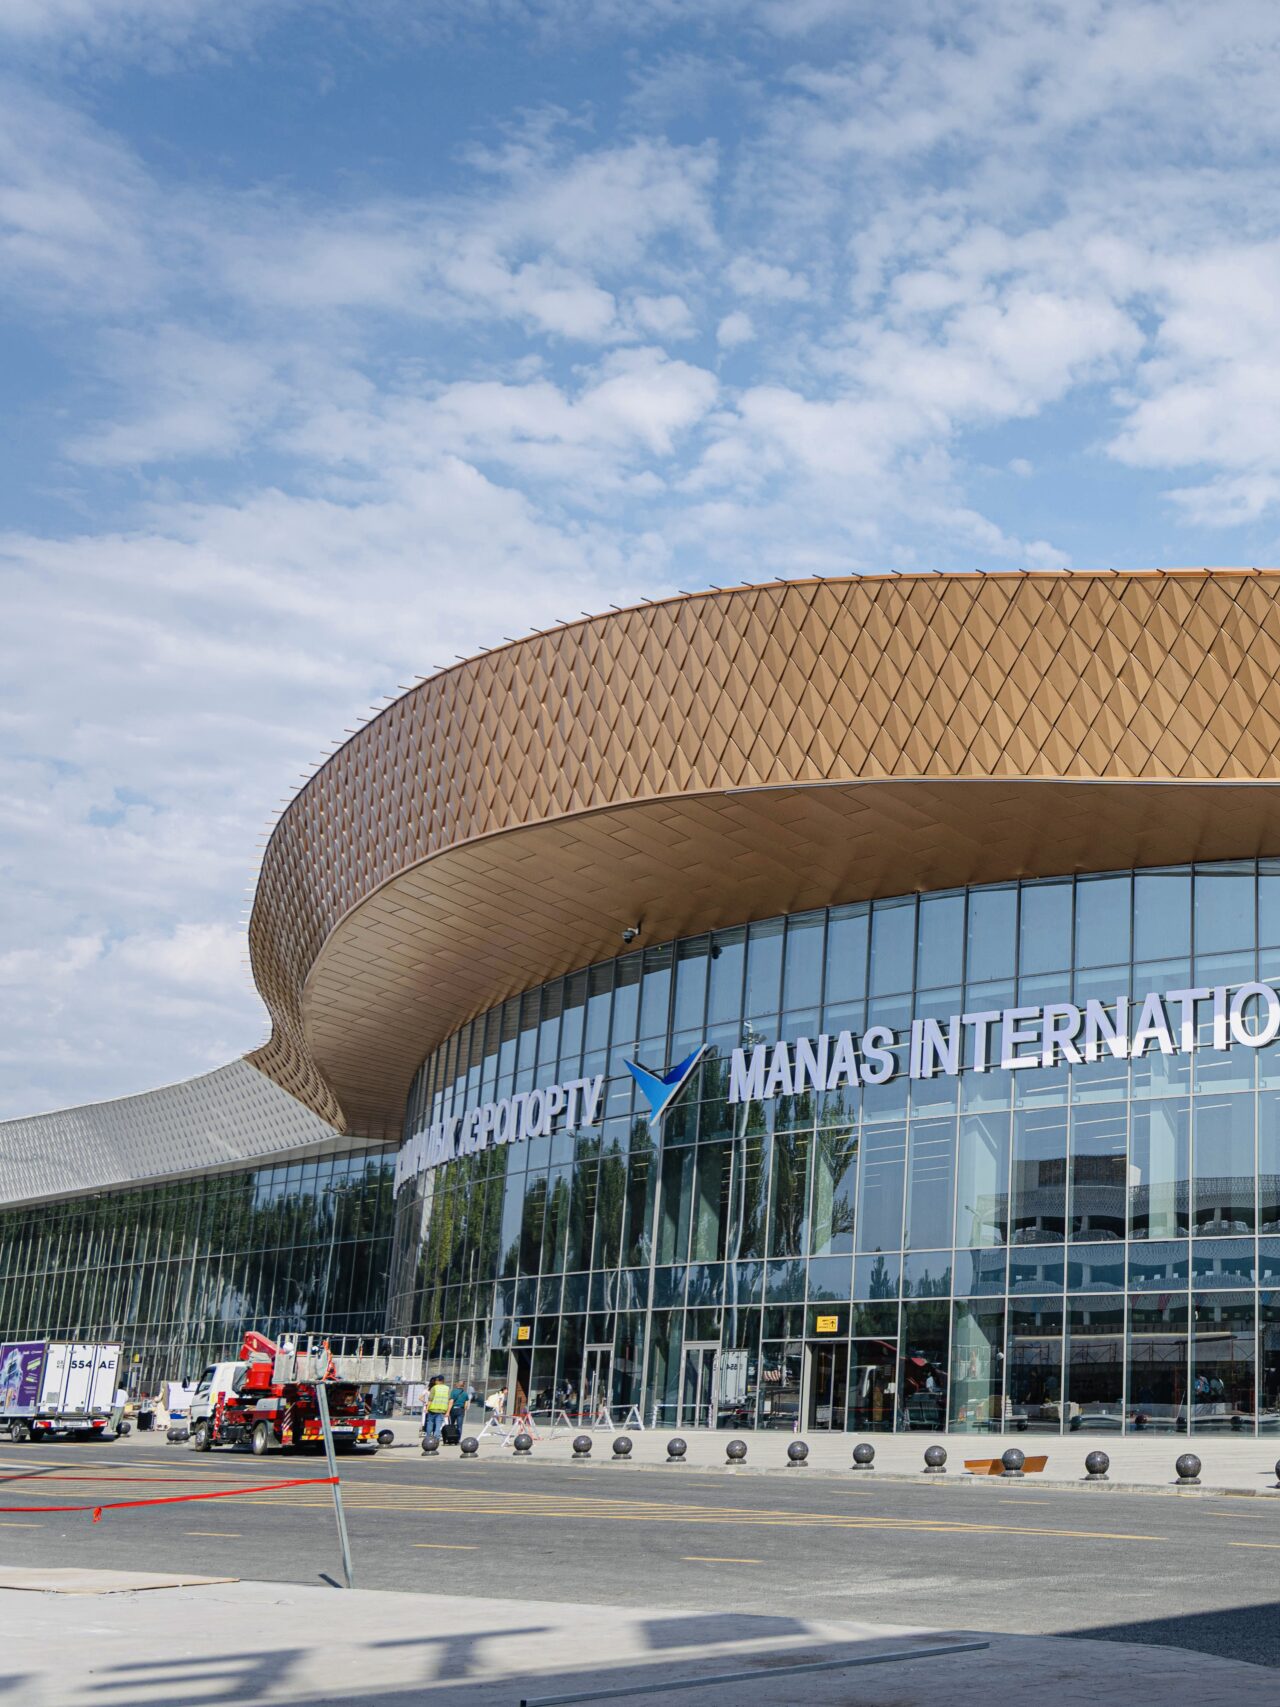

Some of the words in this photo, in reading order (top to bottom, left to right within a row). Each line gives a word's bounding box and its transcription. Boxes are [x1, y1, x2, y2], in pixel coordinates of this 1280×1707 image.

[728, 1026, 896, 1104] MANAS
[458, 1074, 604, 1157] АЭРОПОРТУ
[71, 1360, 93, 1369] 554
[98, 1360, 116, 1369] AE
